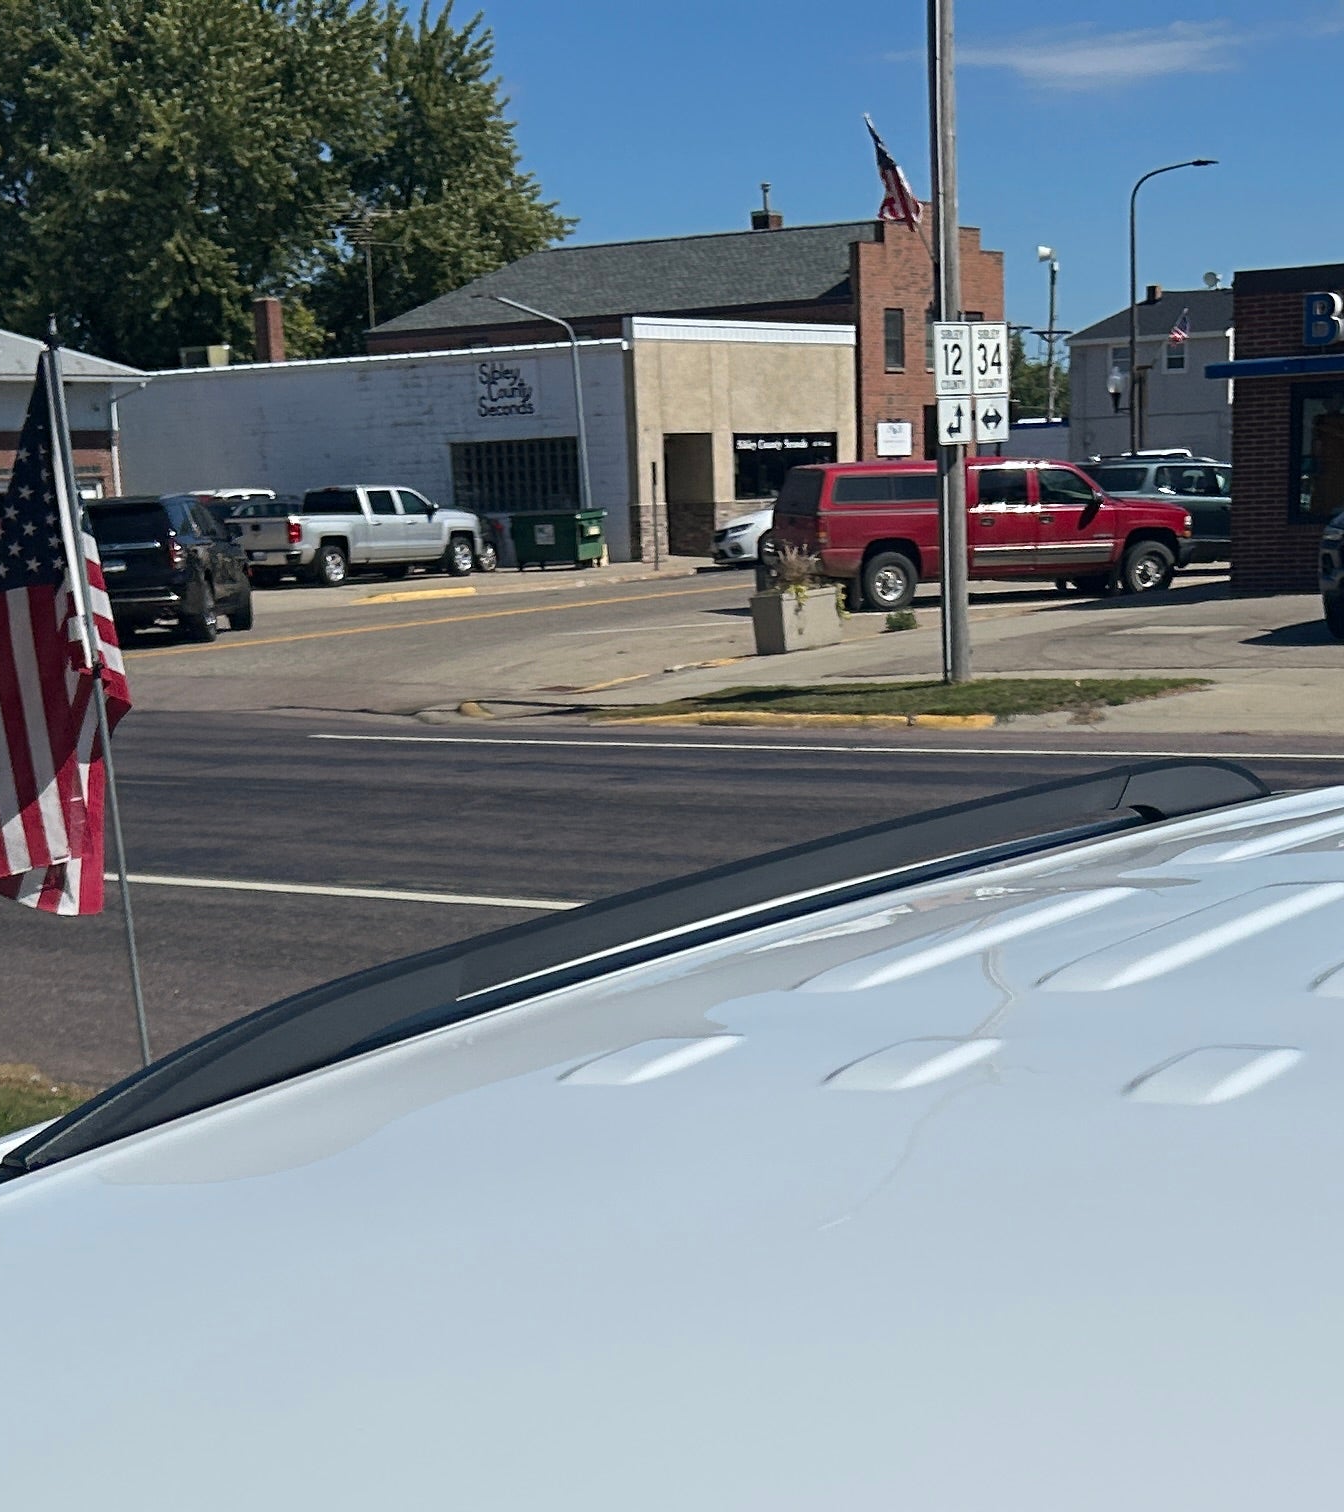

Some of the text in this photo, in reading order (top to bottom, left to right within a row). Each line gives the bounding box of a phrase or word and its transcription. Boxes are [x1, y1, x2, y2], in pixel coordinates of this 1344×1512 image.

[943, 343, 962, 375] 12
[977, 343, 1002, 375] 34
[478, 363, 520, 387] Sibley
[488, 378, 534, 403] County
[477, 396, 536, 417] Seconds
